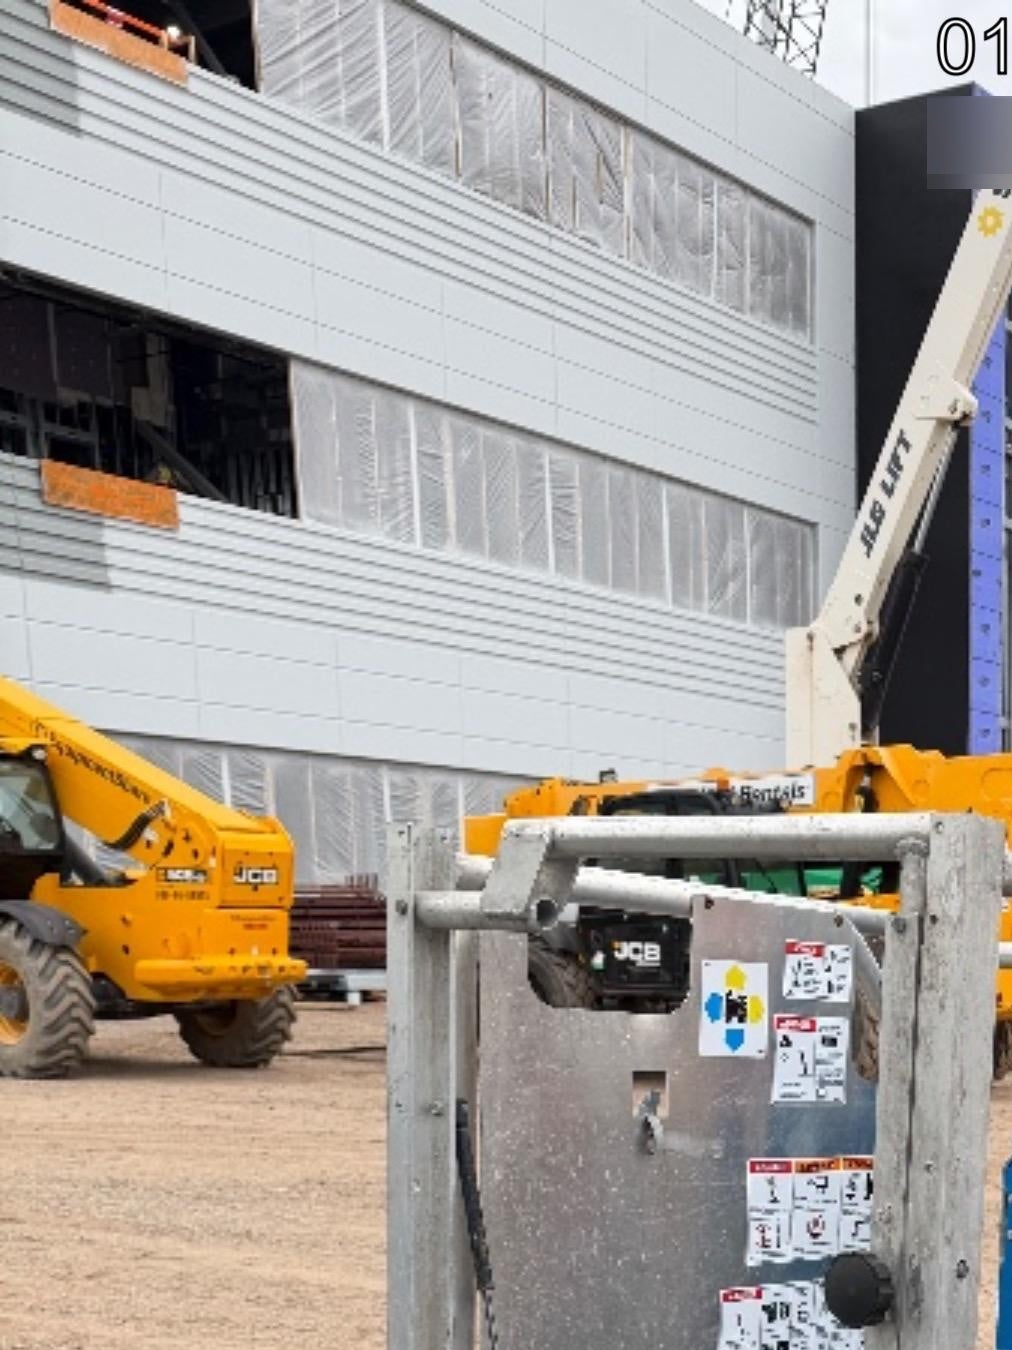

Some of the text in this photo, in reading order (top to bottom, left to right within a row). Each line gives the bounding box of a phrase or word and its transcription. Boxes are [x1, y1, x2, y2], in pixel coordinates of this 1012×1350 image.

[861, 428, 912, 558] JLG LIFT
[234, 867, 277, 883] JCB
[611, 940, 661, 961] JCB
